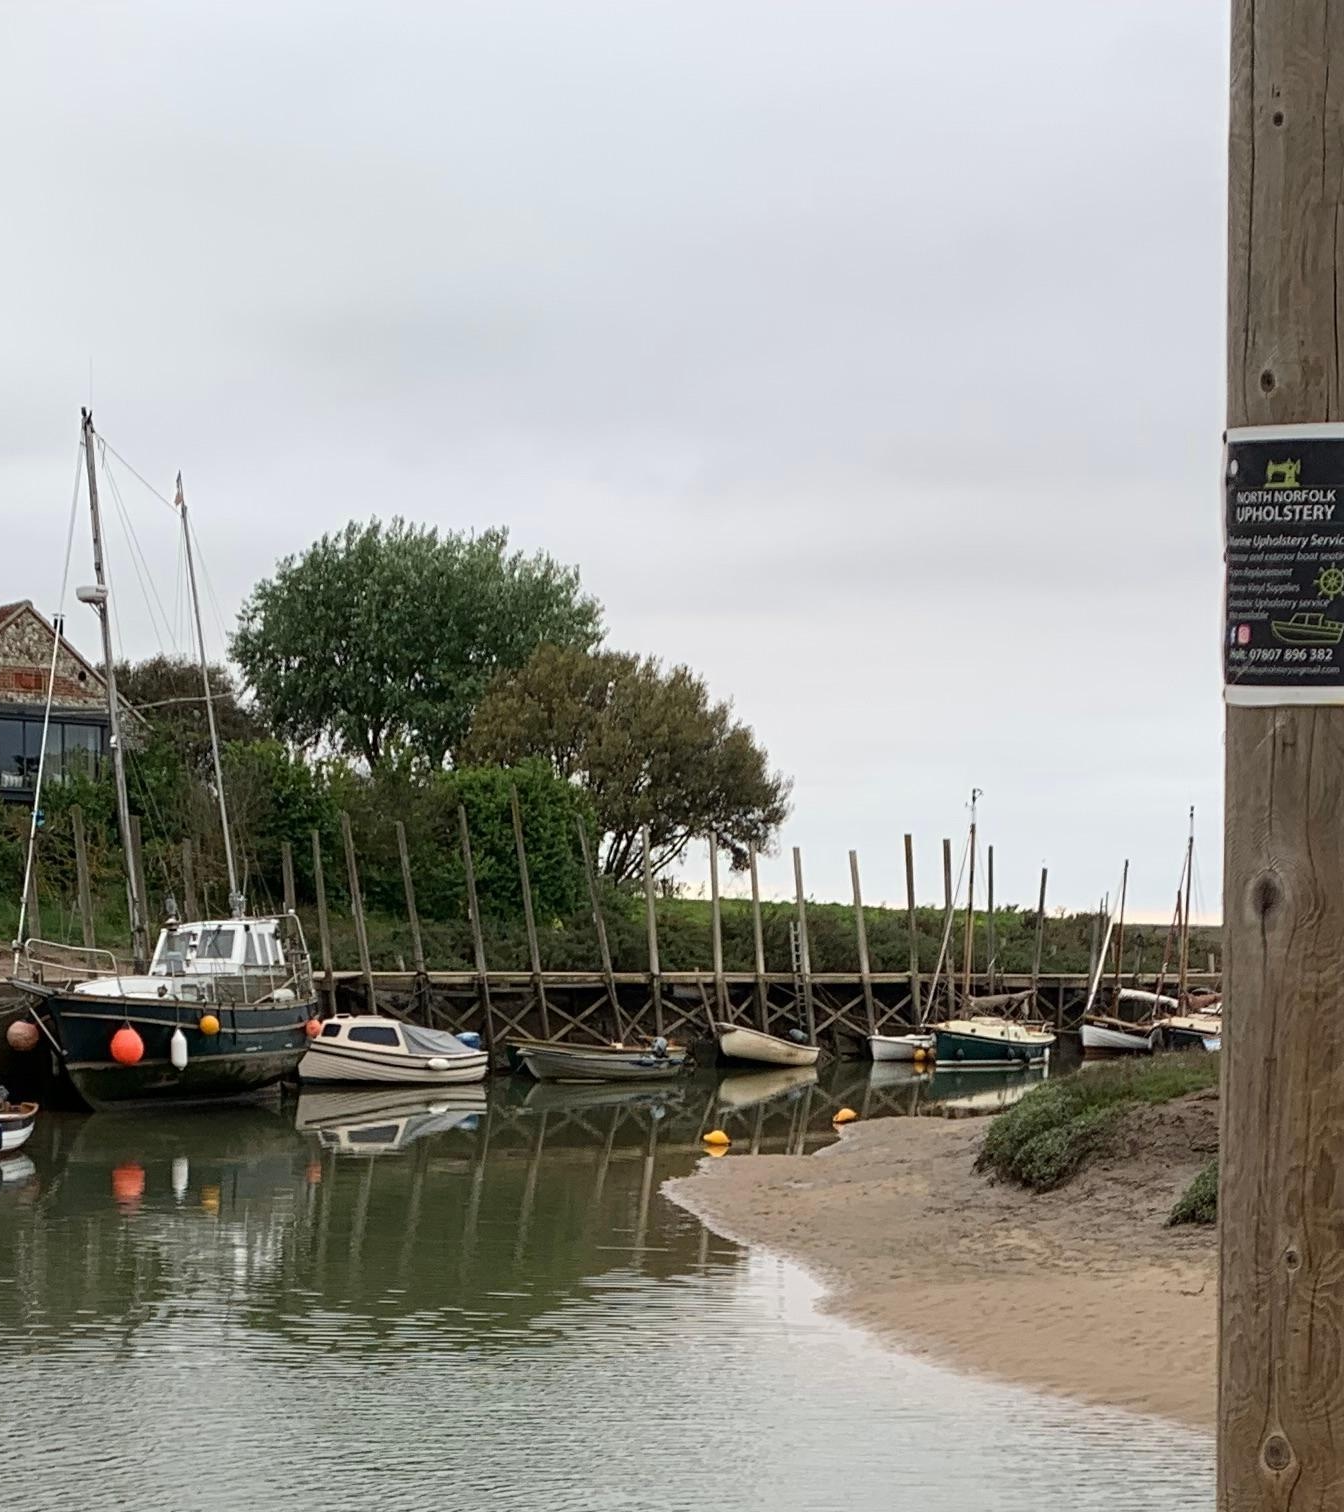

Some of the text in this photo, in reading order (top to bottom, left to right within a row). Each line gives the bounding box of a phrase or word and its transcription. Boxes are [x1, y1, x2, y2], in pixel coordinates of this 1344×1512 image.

[1236, 489, 1336, 503] NORTH NORFOLK
[1236, 504, 1336, 522] UPHOLSTERY
[1253, 533, 1309, 549] Upholstery
[1296, 551, 1319, 561] boat
[1298, 598, 1330, 608] service
[1283, 648, 1308, 660] 896
[1309, 648, 1334, 660] 382
